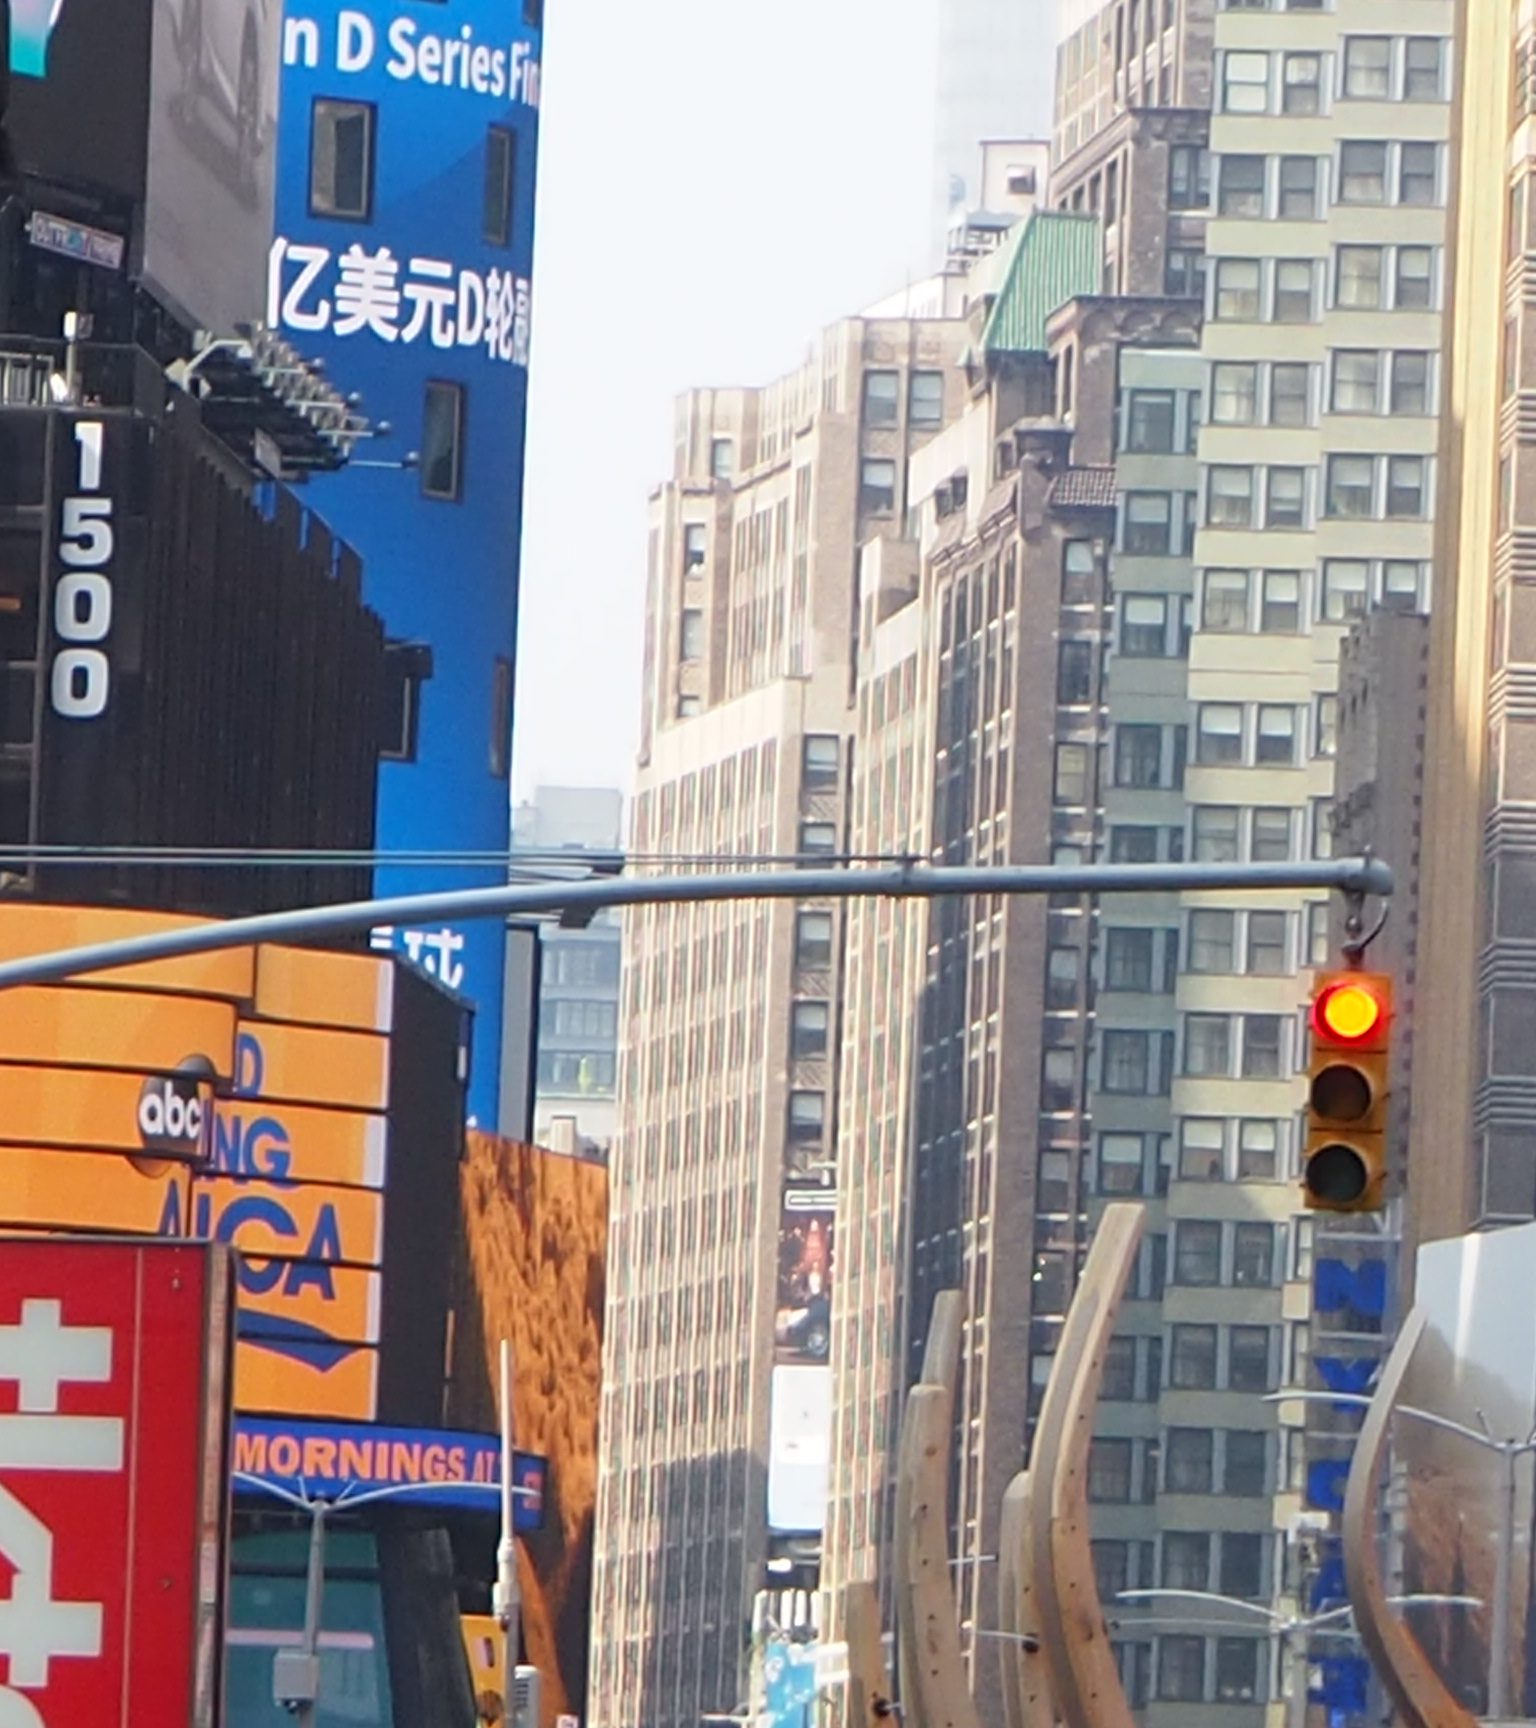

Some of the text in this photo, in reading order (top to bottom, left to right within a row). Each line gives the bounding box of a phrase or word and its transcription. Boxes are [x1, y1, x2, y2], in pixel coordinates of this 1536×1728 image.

[337, 11, 375, 72] D
[386, 17, 506, 97] Series
[51, 421, 114, 718] 1500
[139, 1078, 203, 1140] abc
[233, 1432, 466, 1482] MORNINGS
